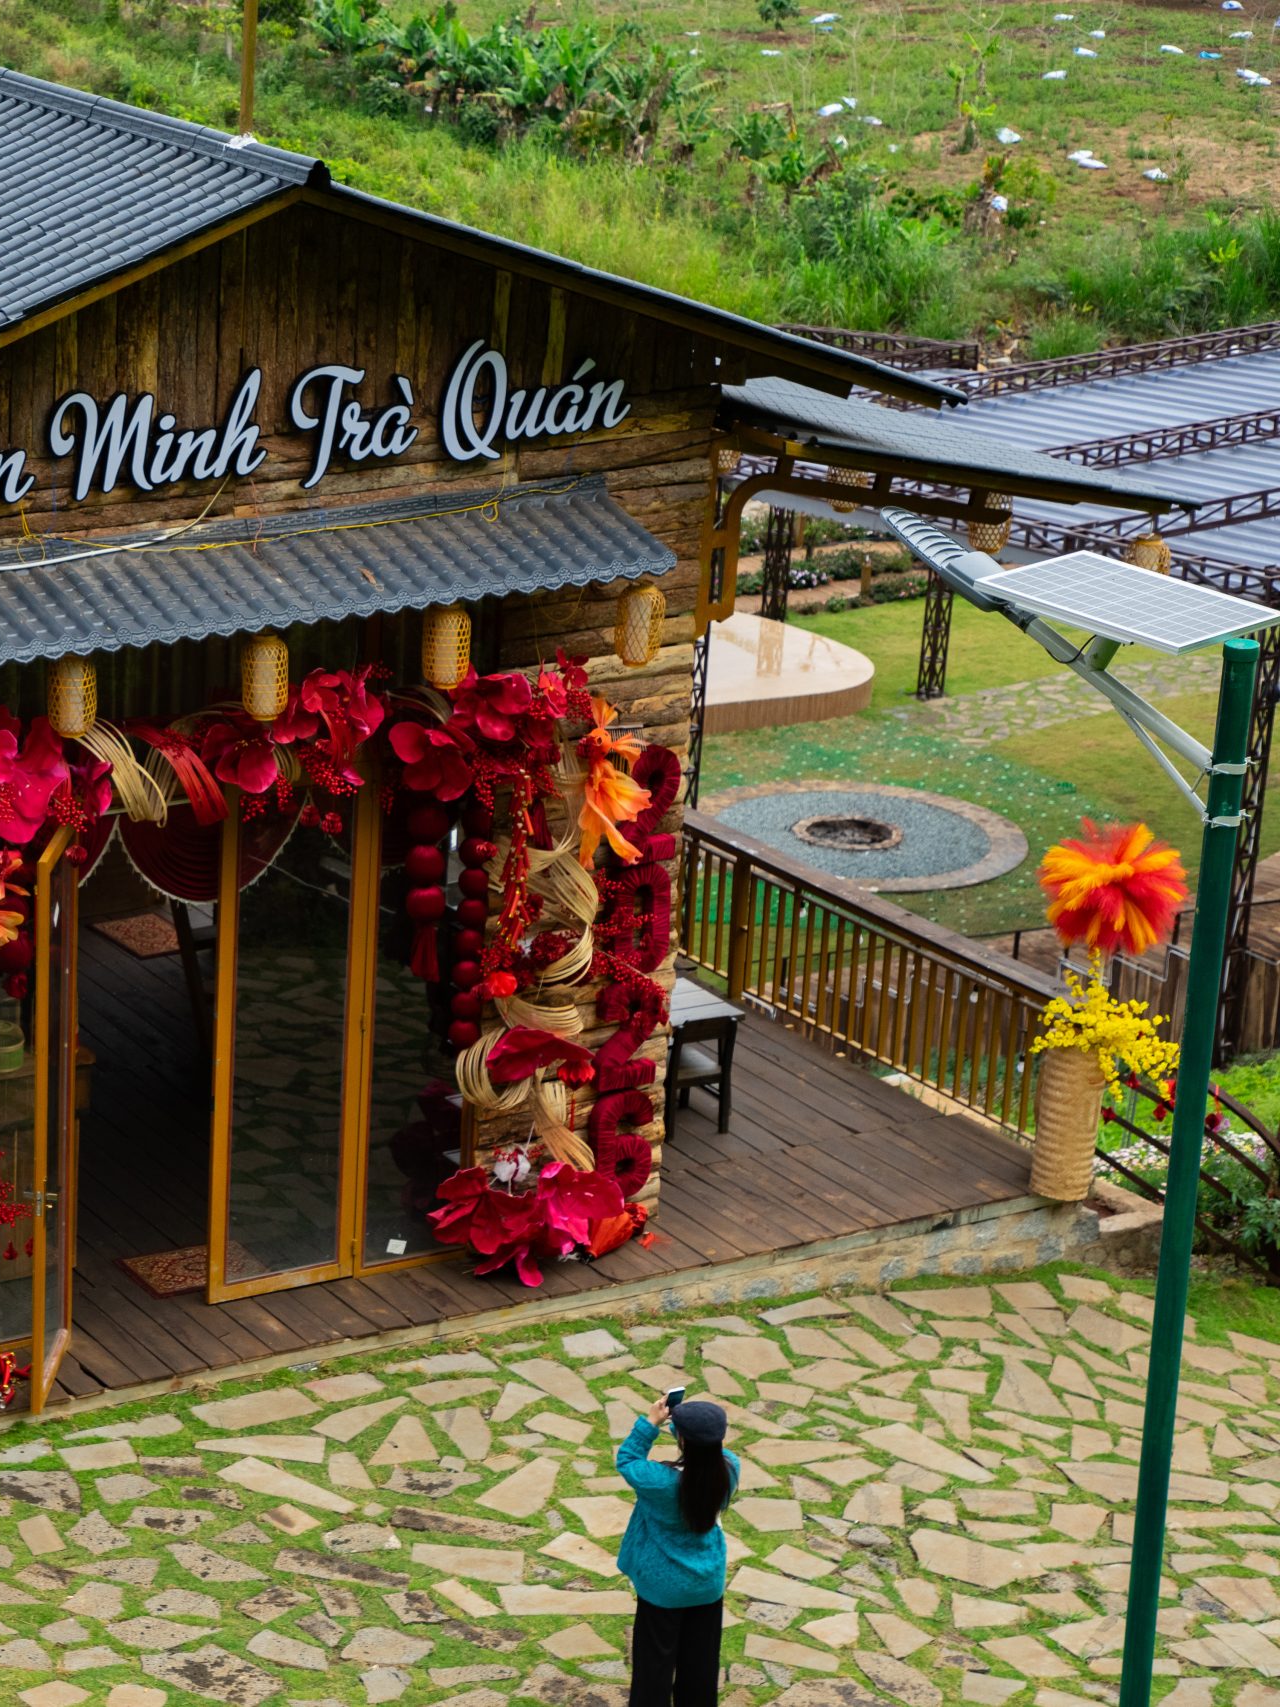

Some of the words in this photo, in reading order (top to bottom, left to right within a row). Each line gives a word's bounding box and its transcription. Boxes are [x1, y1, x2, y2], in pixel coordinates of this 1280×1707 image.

[49, 367, 268, 501] Minh
[290, 364, 419, 489] Trà
[442, 338, 632, 461] Quán
